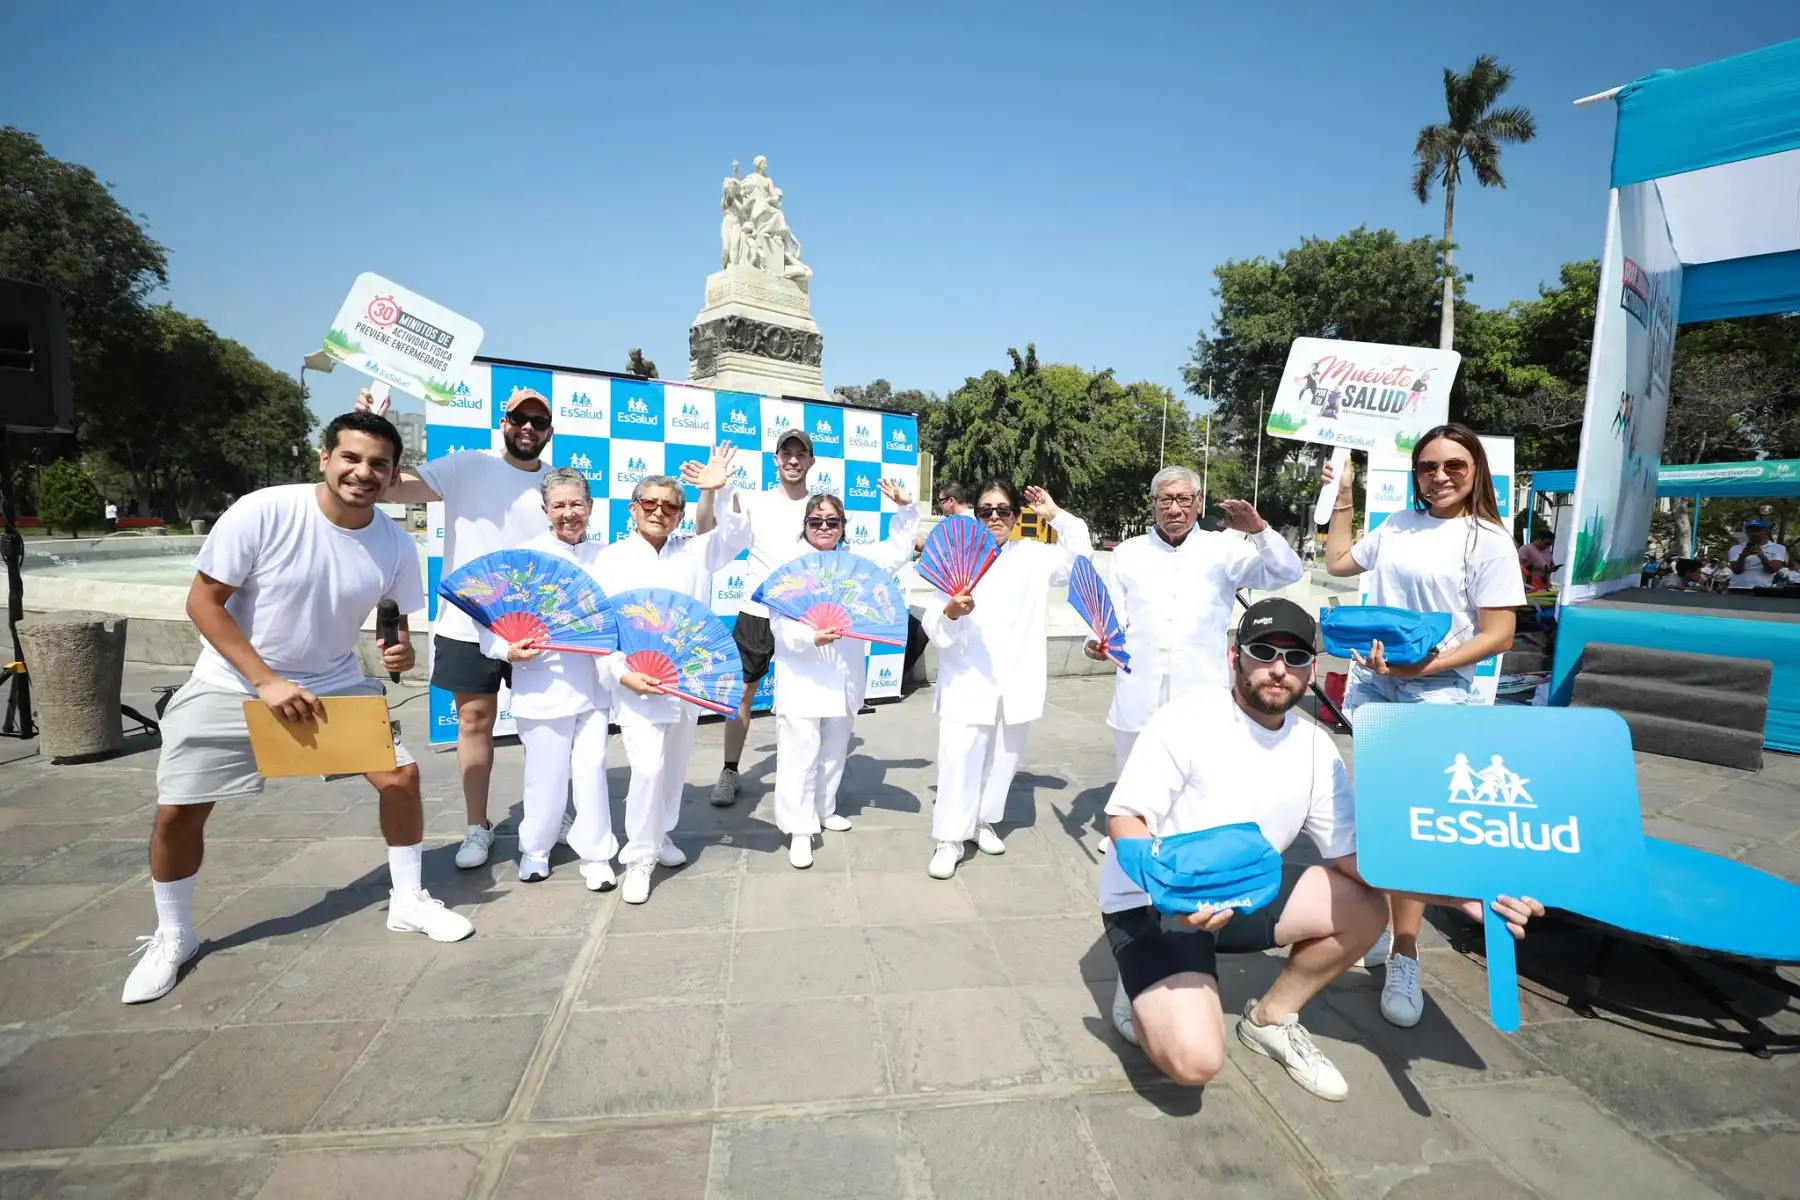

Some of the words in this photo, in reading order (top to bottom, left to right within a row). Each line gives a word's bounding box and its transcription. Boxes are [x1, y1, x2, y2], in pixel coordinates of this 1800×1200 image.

[374, 303, 393, 320] 30
[399, 314, 438, 339] MINUTOS
[438, 333, 452, 346] DE
[392, 328, 430, 351] ACTIVIDAD
[355, 322, 390, 346] PREVIENE
[392, 337, 449, 372] ENFERMEDADES
[449, 397, 482, 409] Salud
[1341, 385, 1407, 413] SALUD
[560, 406, 602, 420] EsSalud
[617, 412, 658, 425] EsSalud
[672, 418, 710, 430] EsSalud
[721, 423, 756, 436] EsSalud
[809, 433, 839, 444] EsSalud
[849, 437, 877, 448] EsSalud
[1335, 432, 1375, 447] EsSalud
[886, 442, 913, 452] EsSalud
[810, 485, 839, 495] EsSalud
[849, 487, 876, 498] EsSalud
[871, 679, 898, 688] EsSalud
[1409, 806, 1580, 854] EsSalud
